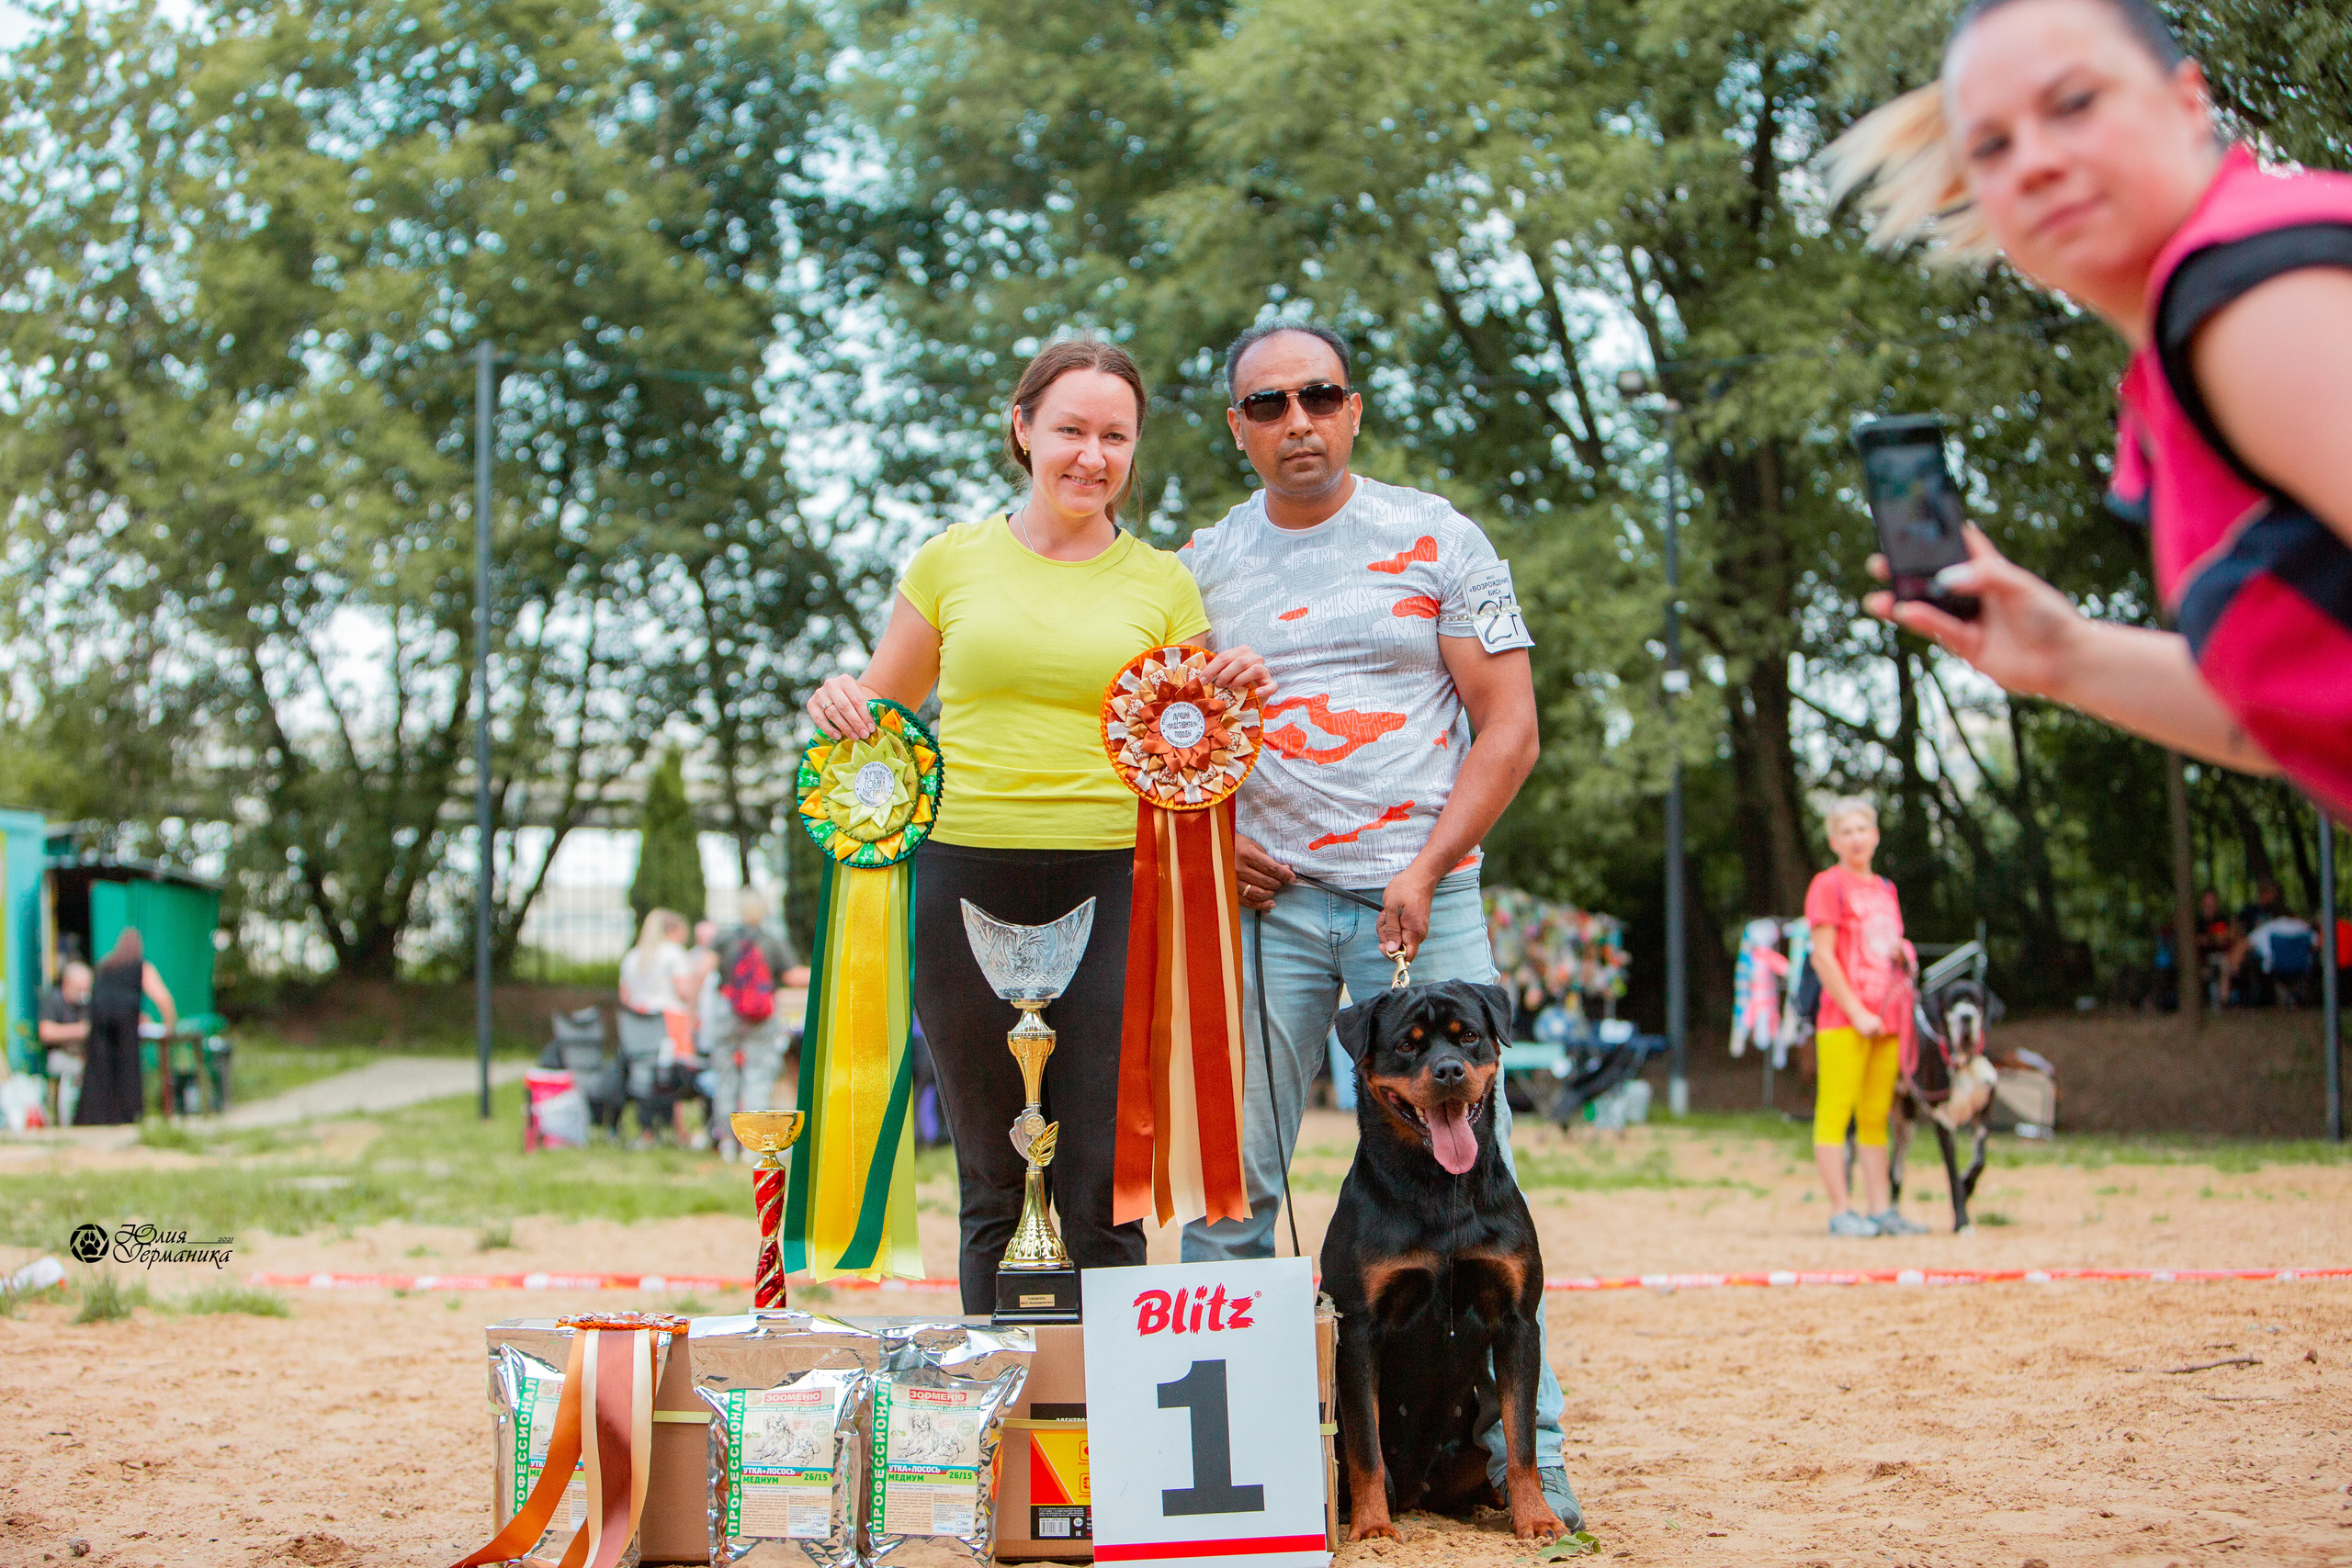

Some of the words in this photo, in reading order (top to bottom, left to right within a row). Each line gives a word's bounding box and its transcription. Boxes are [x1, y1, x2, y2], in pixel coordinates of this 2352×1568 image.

[1133, 1282, 1256, 1337] Blitz
[765, 1392, 820, 1402] ЗООМЕНЮ
[910, 1391, 966, 1402] ЗООМЕНЮ
[1157, 1359, 1265, 1517] 1
[516, 1379, 537, 1514] РОФЕССИОНАЛ
[873, 1382, 889, 1531] ПРОФЕССИОНАЛ
[728, 1392, 743, 1533] ПРОФЕССИОНАЛ
[742, 1476, 779, 1484] МЕДИУМ
[804, 1473, 828, 1482] 26/15
[888, 1473, 924, 1483] МЕДИУМ
[949, 1472, 973, 1480] 26/15
